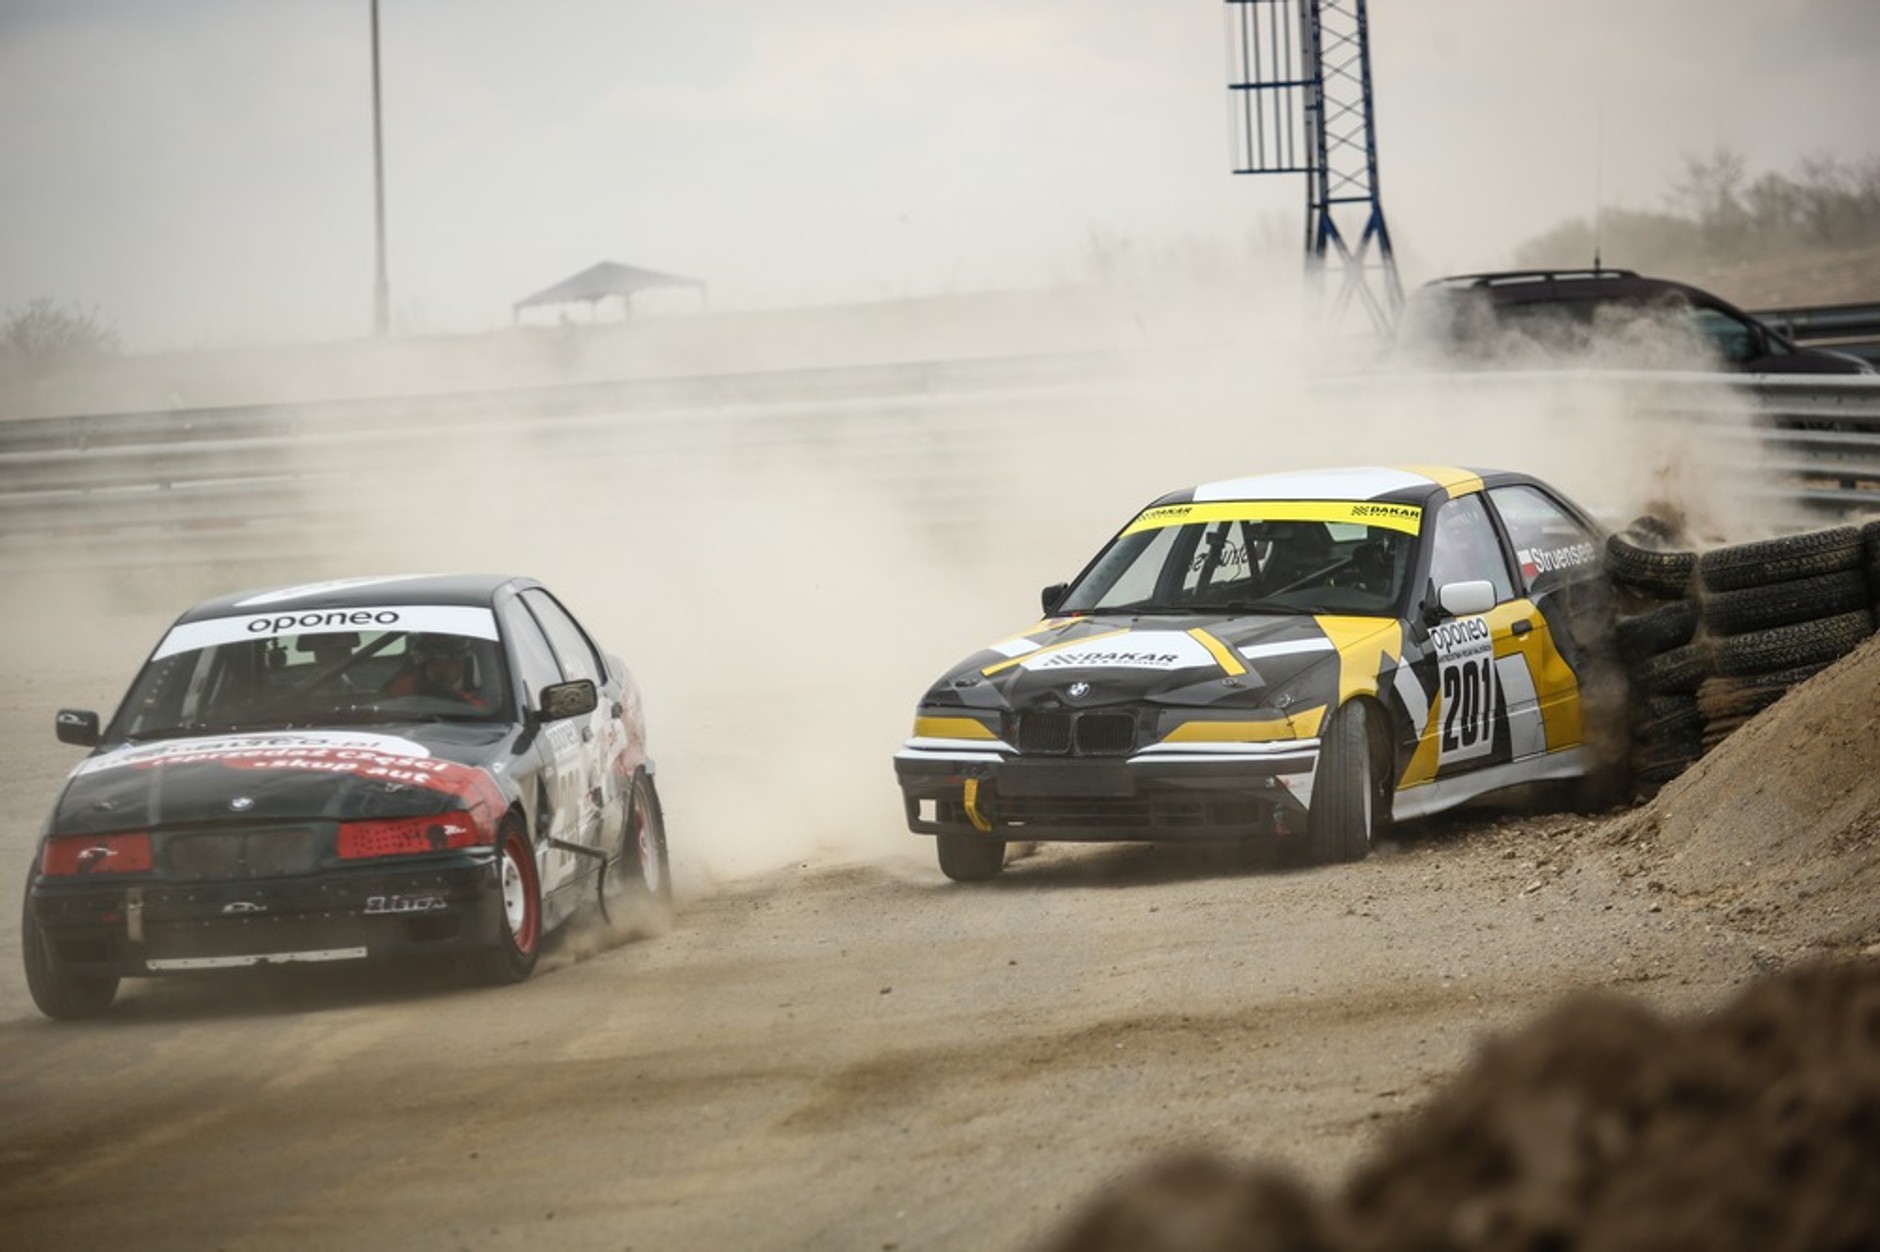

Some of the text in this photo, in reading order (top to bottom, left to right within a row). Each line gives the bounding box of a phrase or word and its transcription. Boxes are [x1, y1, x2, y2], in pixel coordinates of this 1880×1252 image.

[1370, 506, 1419, 518] DAKAR
[1530, 542, 1596, 573] Struensee
[247, 611, 399, 633] oponeo
[1431, 618, 1488, 653] oponeo
[1082, 652, 1179, 663] DAKAR
[1442, 657, 1491, 753] 201
